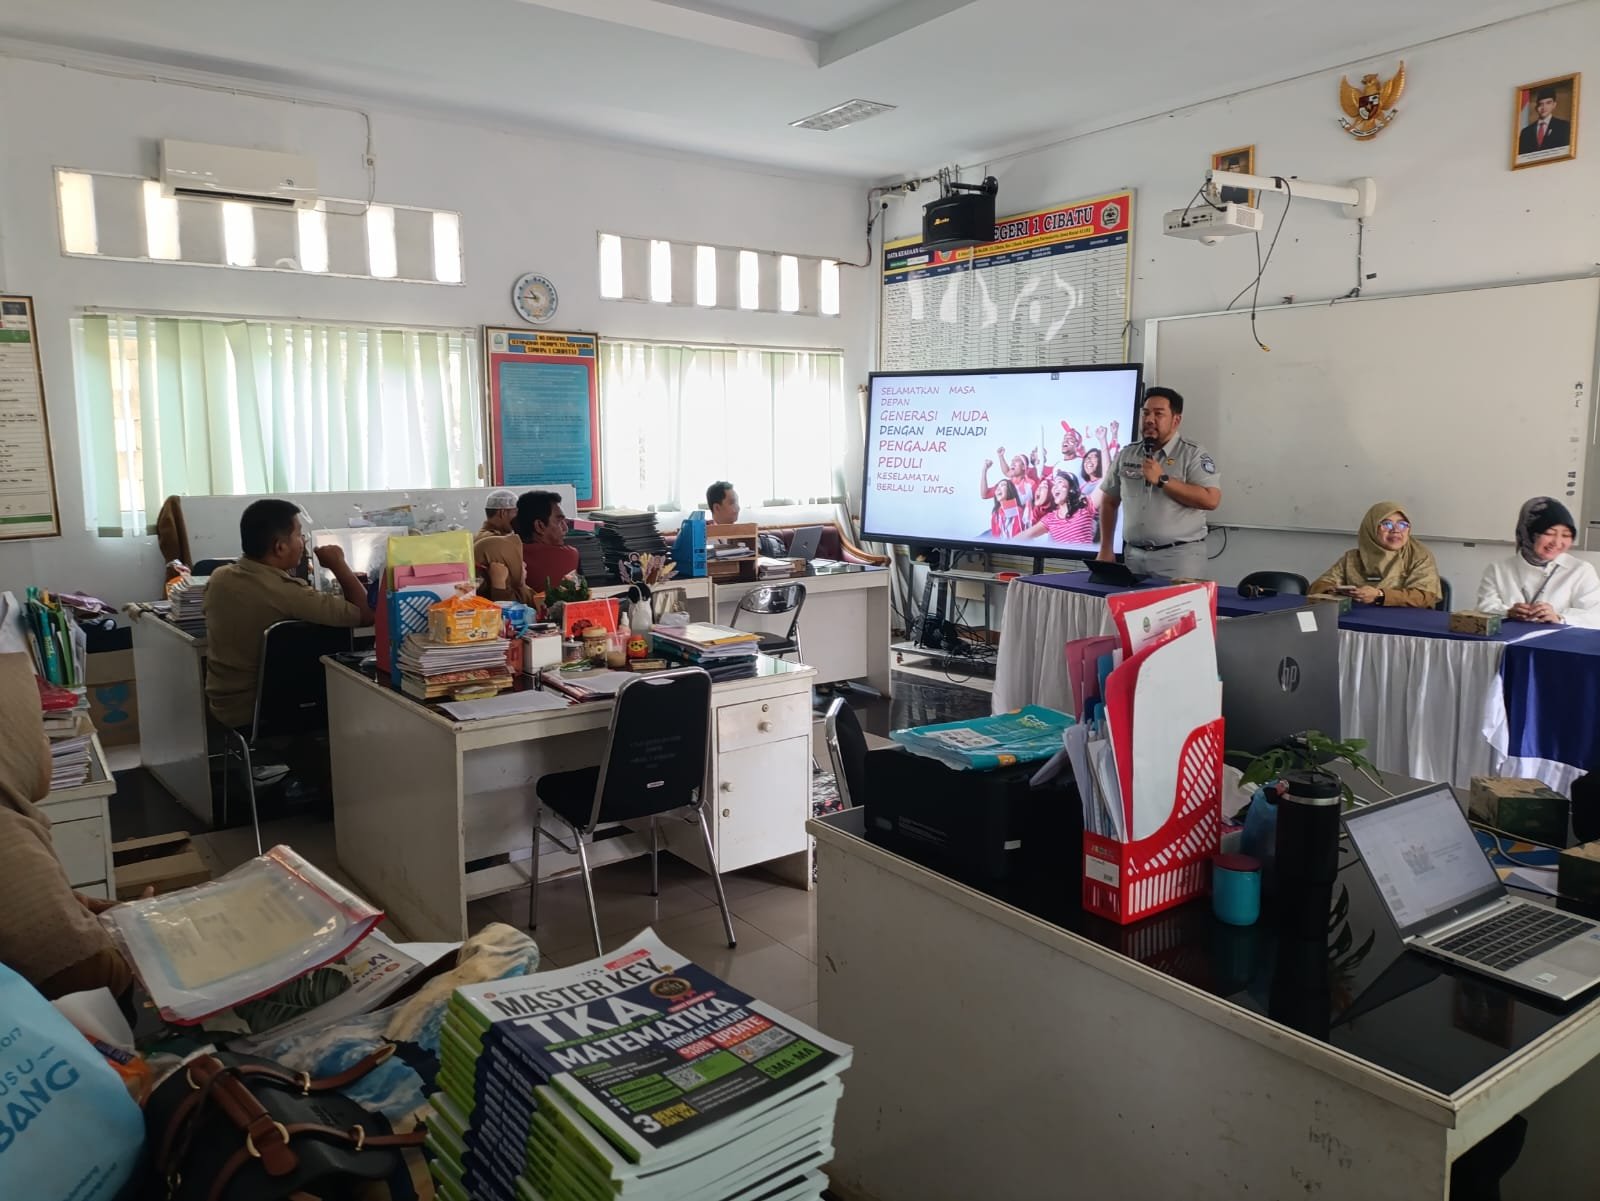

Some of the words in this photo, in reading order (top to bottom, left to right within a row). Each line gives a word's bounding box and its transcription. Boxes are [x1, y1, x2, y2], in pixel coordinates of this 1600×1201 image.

[1033, 219, 1039, 233] 1
[1044, 207, 1093, 231] CIBATU
[881, 387, 940, 396] SELAMATKAN
[949, 386, 976, 395] MASA
[880, 398, 910, 406] DEPAN
[880, 410, 938, 422] GENERASI
[951, 410, 990, 422] MUDA
[879, 425, 925, 436] DENGAN
[936, 426, 987, 437] MENJADI
[879, 440, 947, 453] PENGAJAR
[878, 456, 922, 469] PEDULI
[877, 472, 940, 482] KESELAMATAN
[876, 483, 914, 492] BERLALU
[923, 485, 955, 495] LINTAS
[491, 979, 613, 1017] MASTER
[605, 957, 664, 989] KEY
[514, 996, 659, 1043] TKA
[550, 997, 740, 1070] MATEMATIKA
[662, 1024, 714, 1050] TINGKAT
[710, 1008, 749, 1032] LANJUT
[712, 1015, 762, 1044] UPDATE
[633, 1114, 662, 1134] 3
